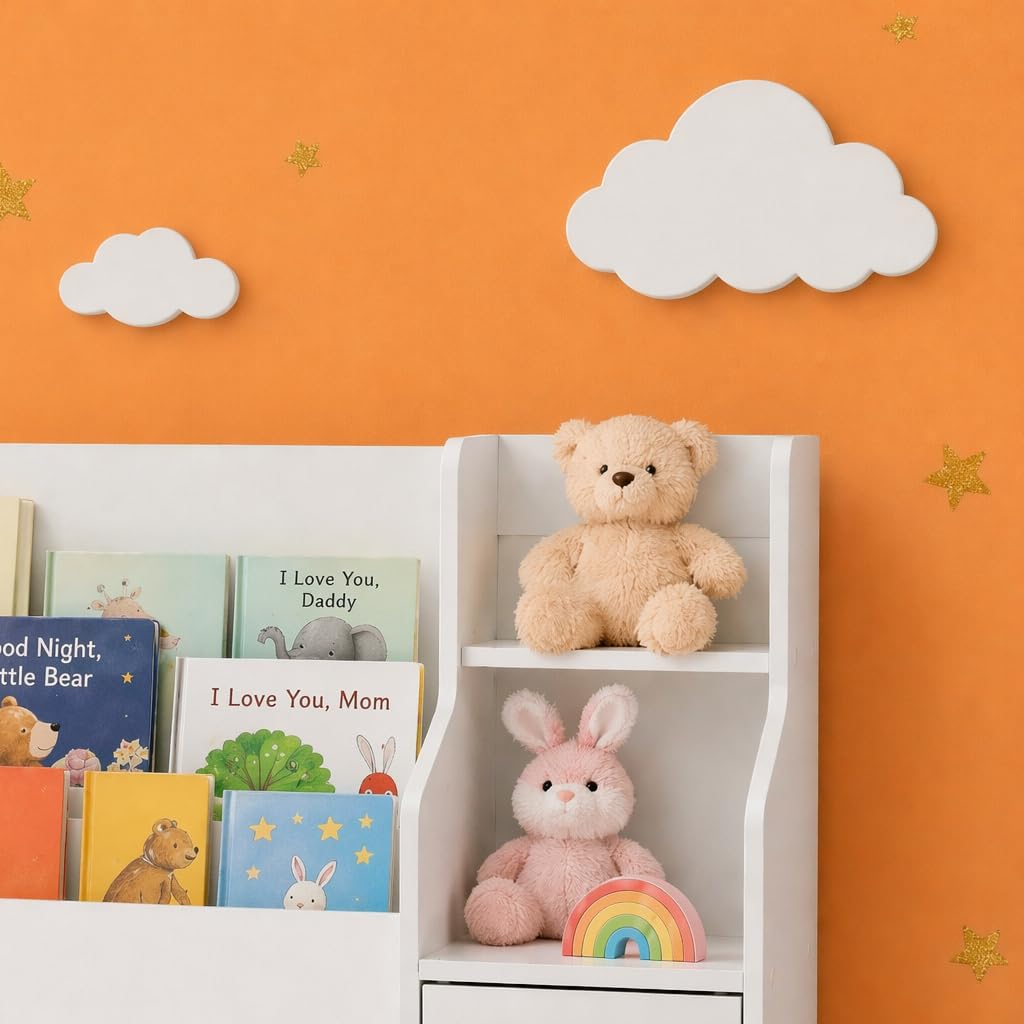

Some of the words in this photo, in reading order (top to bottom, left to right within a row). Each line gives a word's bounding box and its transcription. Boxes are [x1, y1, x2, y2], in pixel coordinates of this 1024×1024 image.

[279, 570, 287, 585] I
[294, 570, 335, 586] Love
[342, 571, 380, 589] You,
[302, 592, 357, 612] Daddy
[37, 637, 102, 664] Night,
[44, 666, 93, 687] Bear
[210, 687, 219, 706] I
[228, 688, 277, 707] Love
[286, 689, 330, 711] You,
[339, 690, 391, 710] Mom
